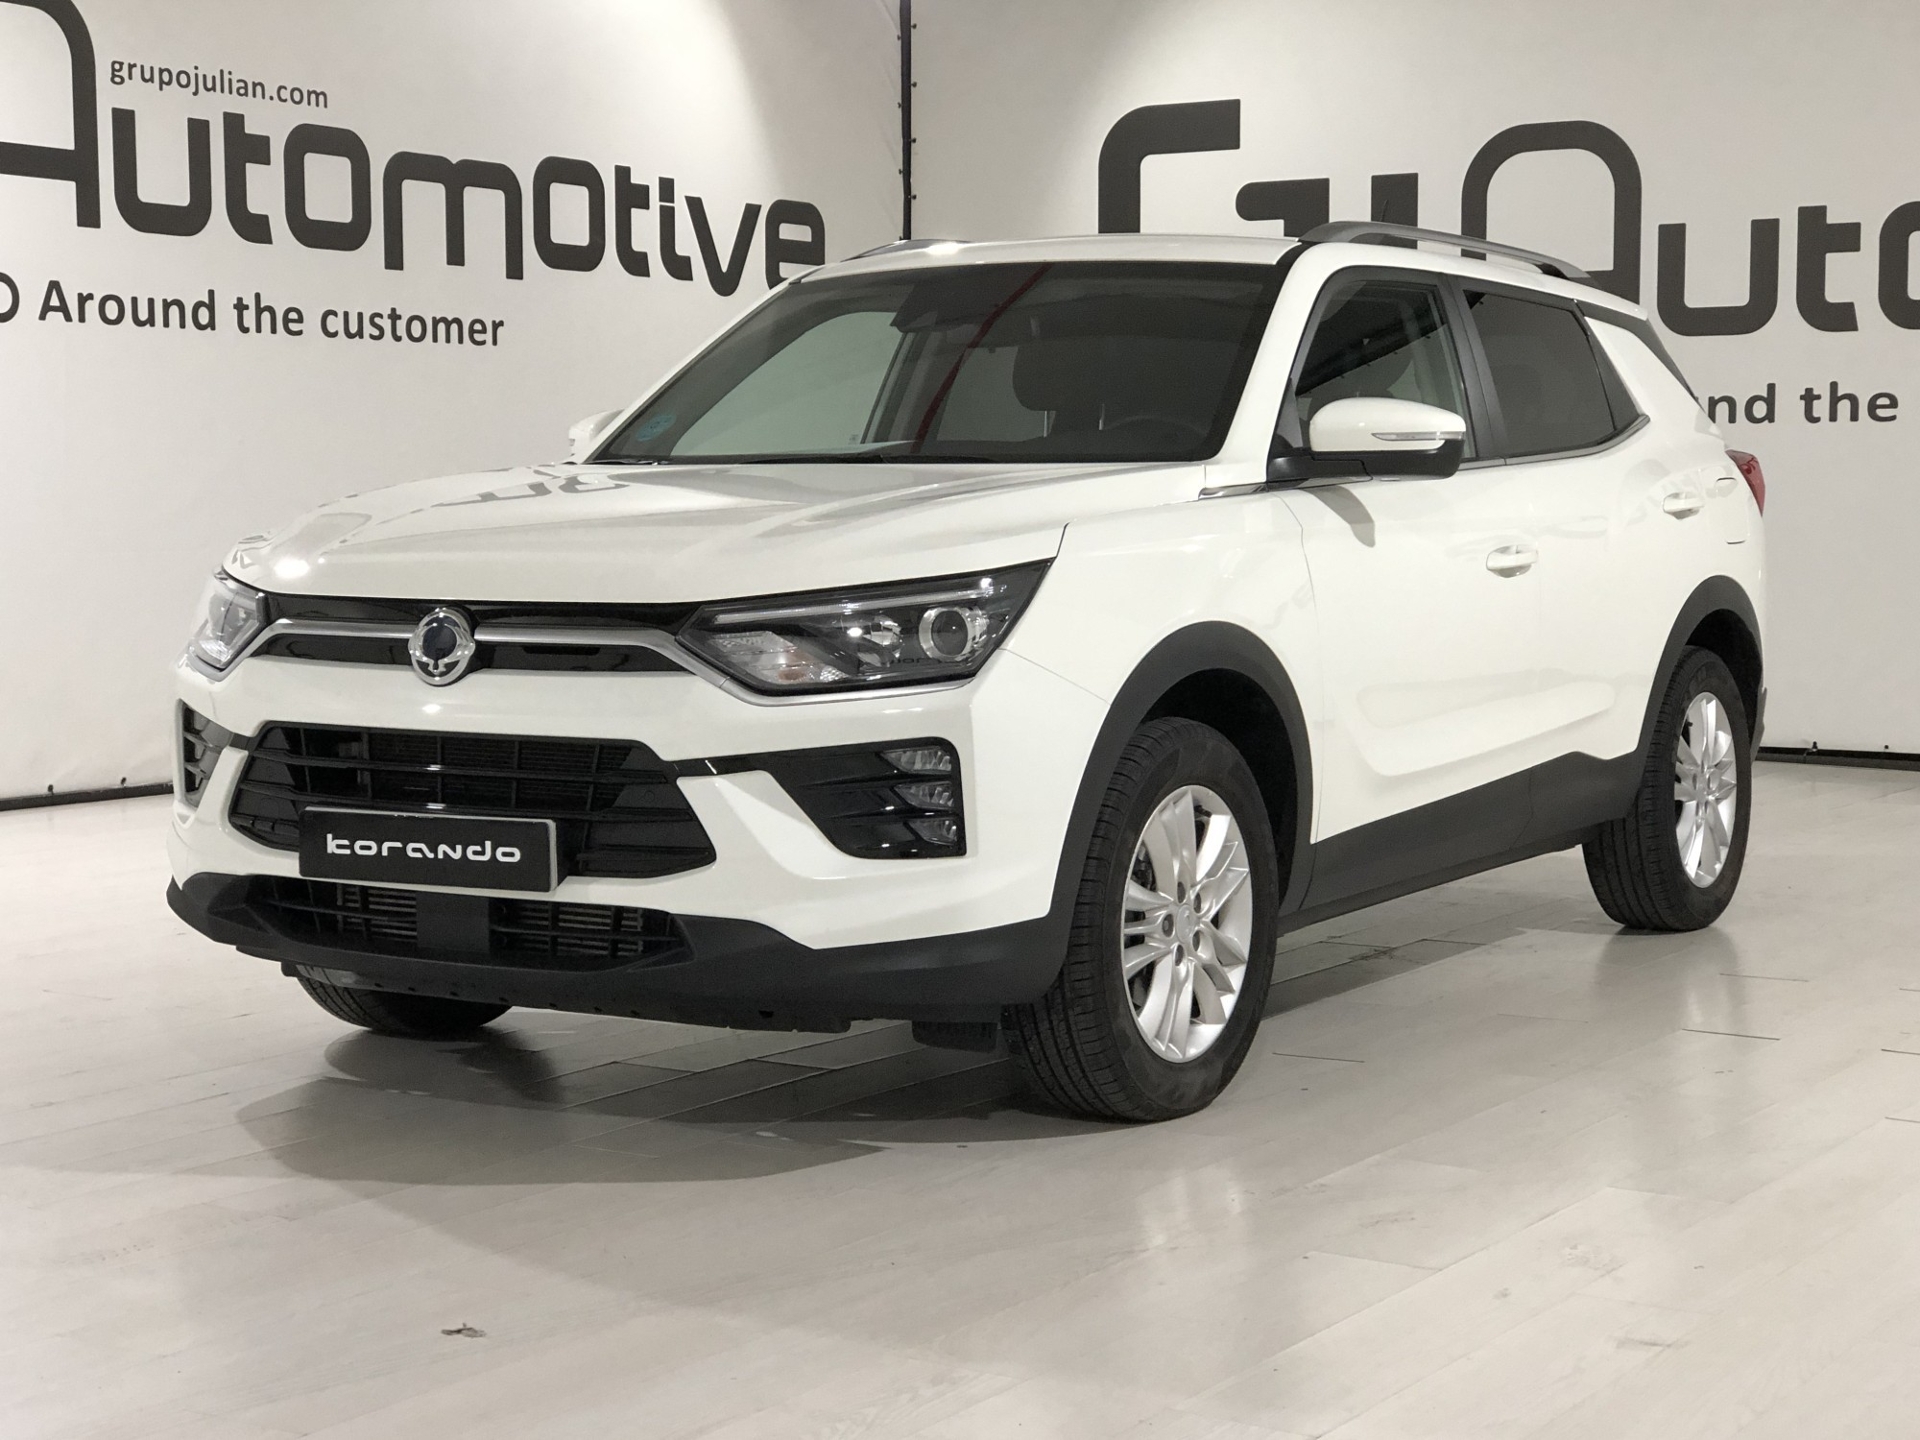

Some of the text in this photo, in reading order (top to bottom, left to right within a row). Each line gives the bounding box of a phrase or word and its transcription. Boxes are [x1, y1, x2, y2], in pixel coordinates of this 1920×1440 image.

[110, 60, 328, 109] grupojulian.com
[38, 280, 216, 331] Around
[232, 292, 304, 337] the
[320, 307, 505, 347] customer
[1697, 380, 1899, 424] nd the
